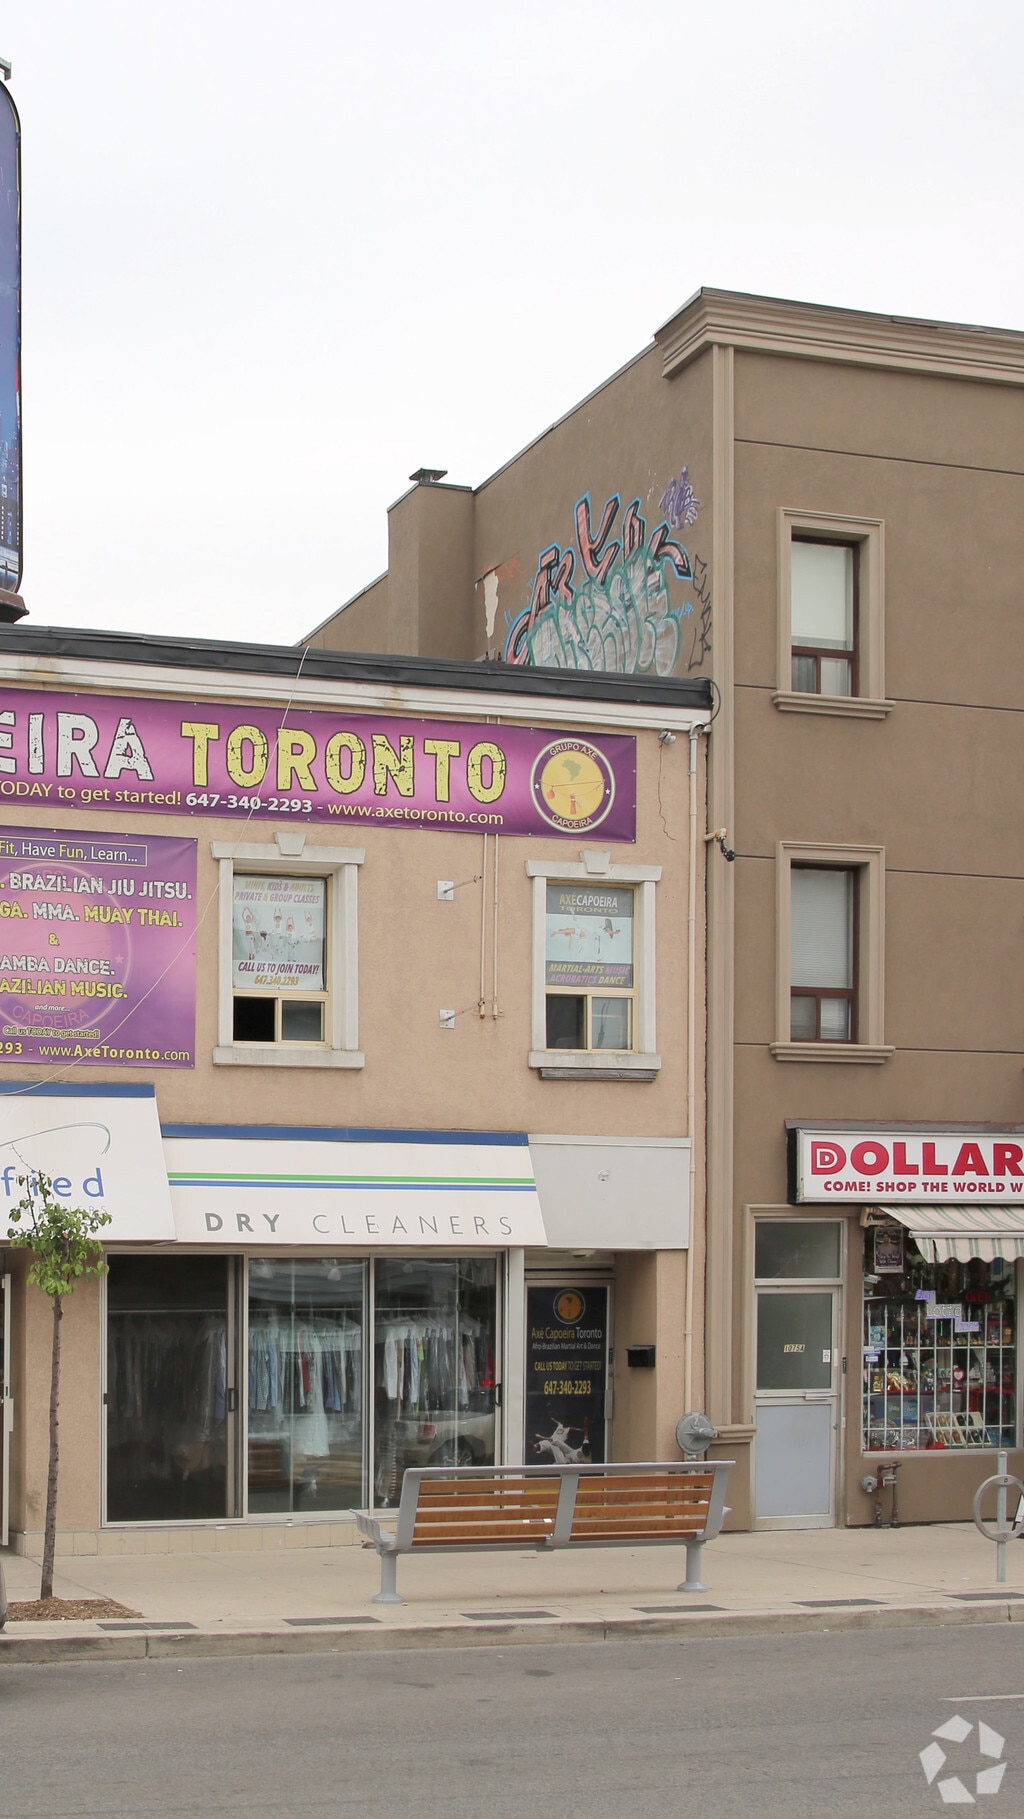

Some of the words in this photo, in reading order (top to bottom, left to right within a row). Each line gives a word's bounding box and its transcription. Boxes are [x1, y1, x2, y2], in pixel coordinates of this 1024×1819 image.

[549, 742, 579, 756] GRUPO
[180, 720, 507, 804] TORONTO
[57, 785, 76, 800] to
[81, 787, 110, 804] get
[115, 790, 181, 806] started!
[186, 793, 313, 814] 647-340-2293
[328, 803, 504, 826] www.axetoronto.com
[551, 814, 593, 829] CAPOEIRA
[21, 843, 56, 857] Have
[59, 844, 87, 860] Fun,
[91, 846, 138, 862] Learn...
[9, 872, 103, 894] BRAZILIAN
[107, 878, 135, 896] JIU
[138, 880, 192, 900] JITSU.
[235, 892, 263, 901] PRIVATE
[269, 893, 293, 903] GROUP
[293, 895, 320, 904] CLASSES
[83, 905, 134, 924] MUAY
[559, 905, 618, 914] TORONTO
[48, 933, 60, 946] &
[54, 956, 115, 976] DANCE.
[238, 961, 255, 972] CALL
[256, 962, 267, 972] US
[267, 963, 277, 973] TO
[275, 964, 293, 975] JOIN
[295, 964, 320, 975] TODAY!
[549, 964, 604, 974] MARTIAL-ARTS
[604, 966, 630, 975] MUSIC
[598, 976, 626, 985] DANCE
[71, 981, 128, 998] MUSIC.
[12, 1005, 89, 1028] CAPOEIRA
[4, 1026, 17, 1035] Call
[27, 1027, 53, 1036] TODAY
[60, 1030, 73, 1038] get
[39, 1044, 190, 1061] www.AxeToronto.com
[811, 1141, 1024, 1176] DOLLAR
[823, 1180, 871, 1192] COME!
[876, 1181, 917, 1192] SHOP
[922, 1182, 948, 1192] THE
[953, 1182, 1005, 1193] WORLD
[204, 1213, 280, 1233] DRY
[312, 1214, 513, 1236] CLEANERS
[545, 1326, 575, 1341] Capoeira
[576, 1326, 602, 1339] Toronto
[534, 1361, 545, 1371] CALL
[546, 1361, 552, 1371] US
[552, 1361, 567, 1371] TODAY
[544, 1380, 592, 1395] 647-340-2293
